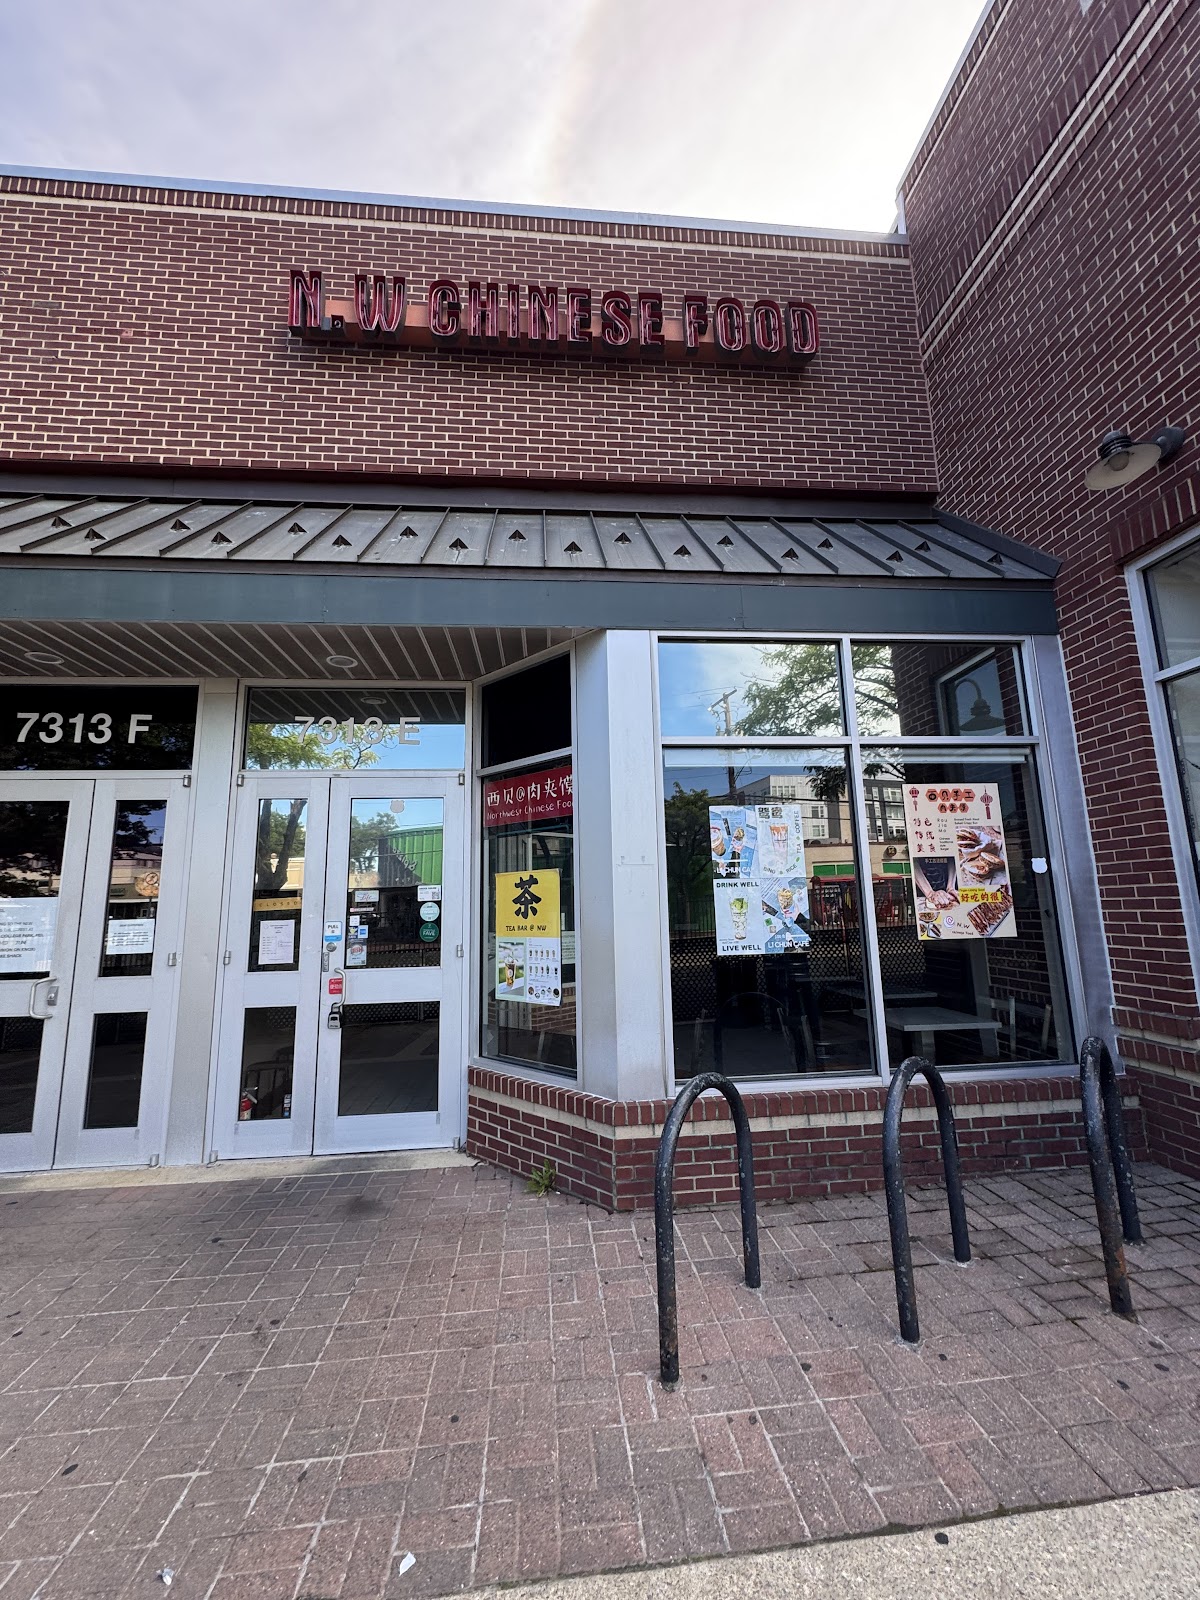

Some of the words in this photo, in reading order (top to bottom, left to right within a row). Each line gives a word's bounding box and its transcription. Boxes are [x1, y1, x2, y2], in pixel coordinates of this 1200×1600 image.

[289, 269, 346, 334] N.
[355, 274, 407, 334] W
[428, 279, 666, 347] CHINESE
[683, 294, 822, 359] FOOD
[16, 712, 112, 744] 7313
[127, 714, 153, 744] F
[294, 716, 383, 745] 7313
[398, 716, 421, 745] E
[486, 808, 522, 821] Northwest
[524, 802, 554, 814] Chinese
[556, 799, 573, 810] Foo
[512, 874, 542, 920] 茶
[961, 892, 1000, 902] 好吃的很
